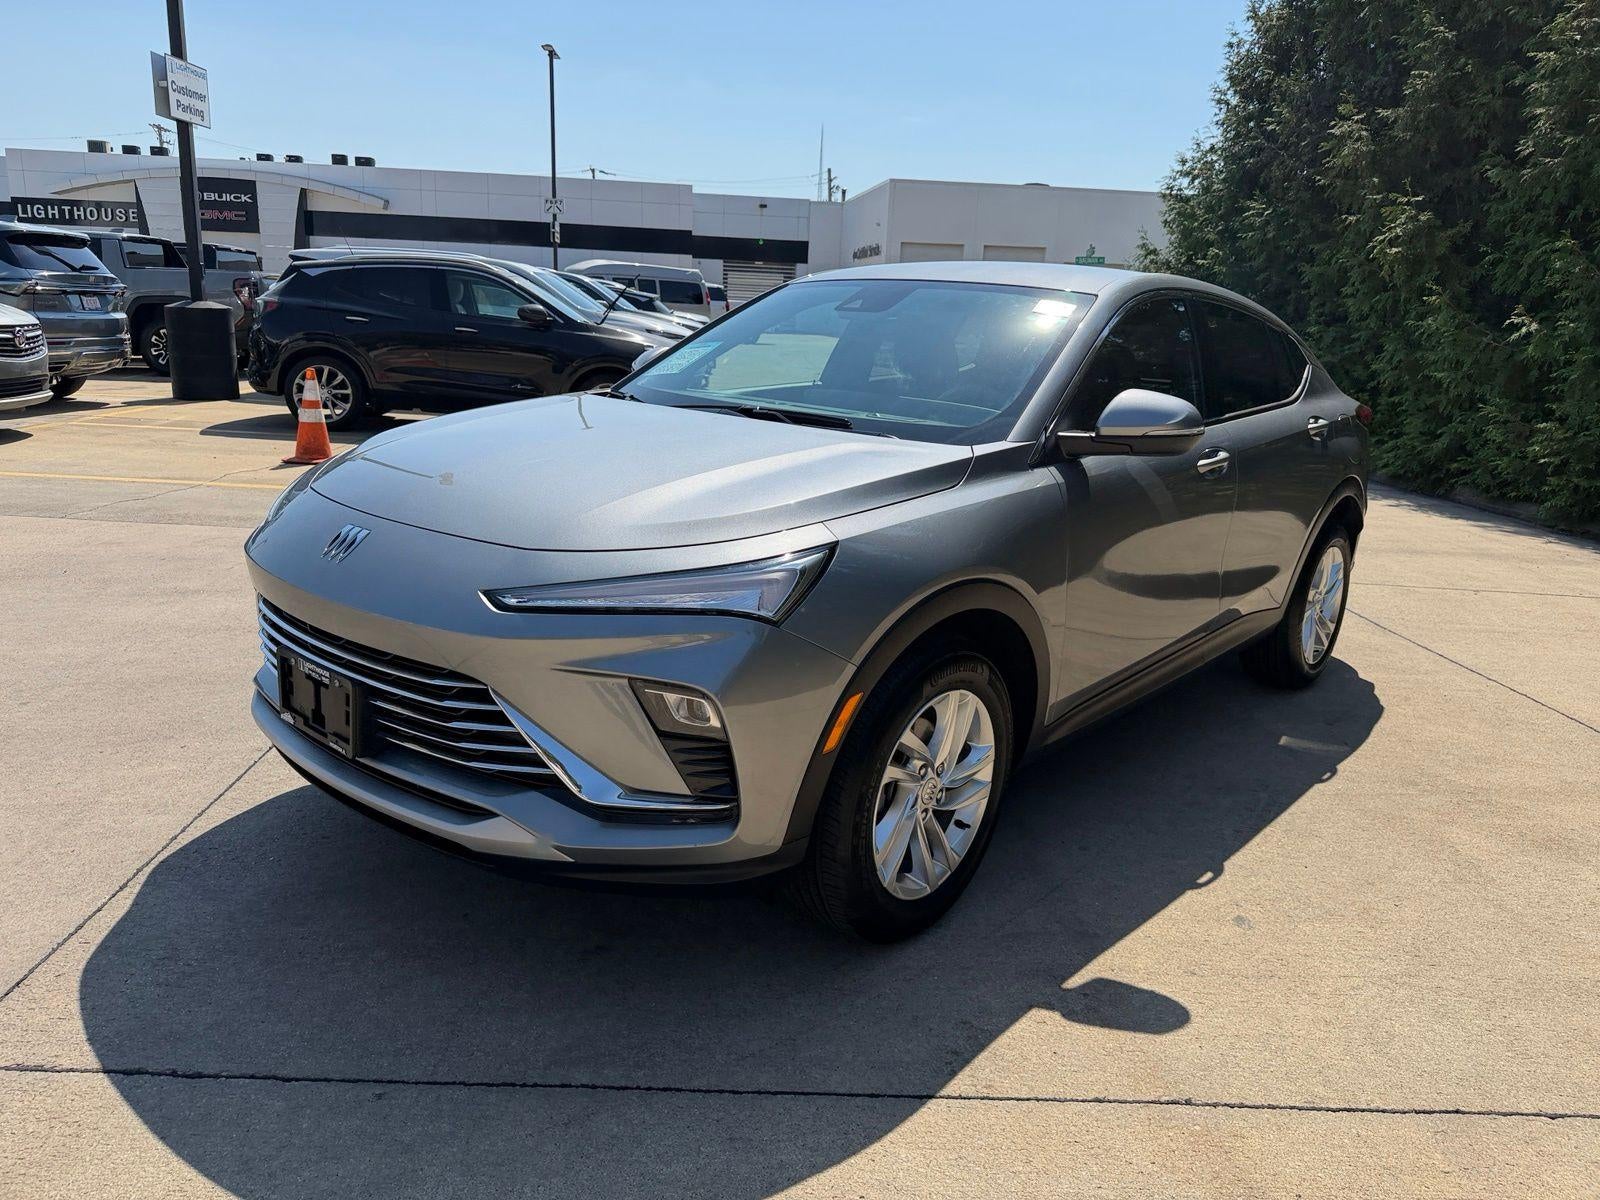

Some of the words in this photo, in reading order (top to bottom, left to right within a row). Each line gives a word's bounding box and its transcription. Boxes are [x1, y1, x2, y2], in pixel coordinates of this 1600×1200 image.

[176, 63, 207, 80] LIGHTHOUSE
[171, 80, 206, 103] Customer
[176, 99, 204, 122] Parking
[203, 192, 253, 203] BUICK
[17, 203, 139, 222] LIGHTHOUSE
